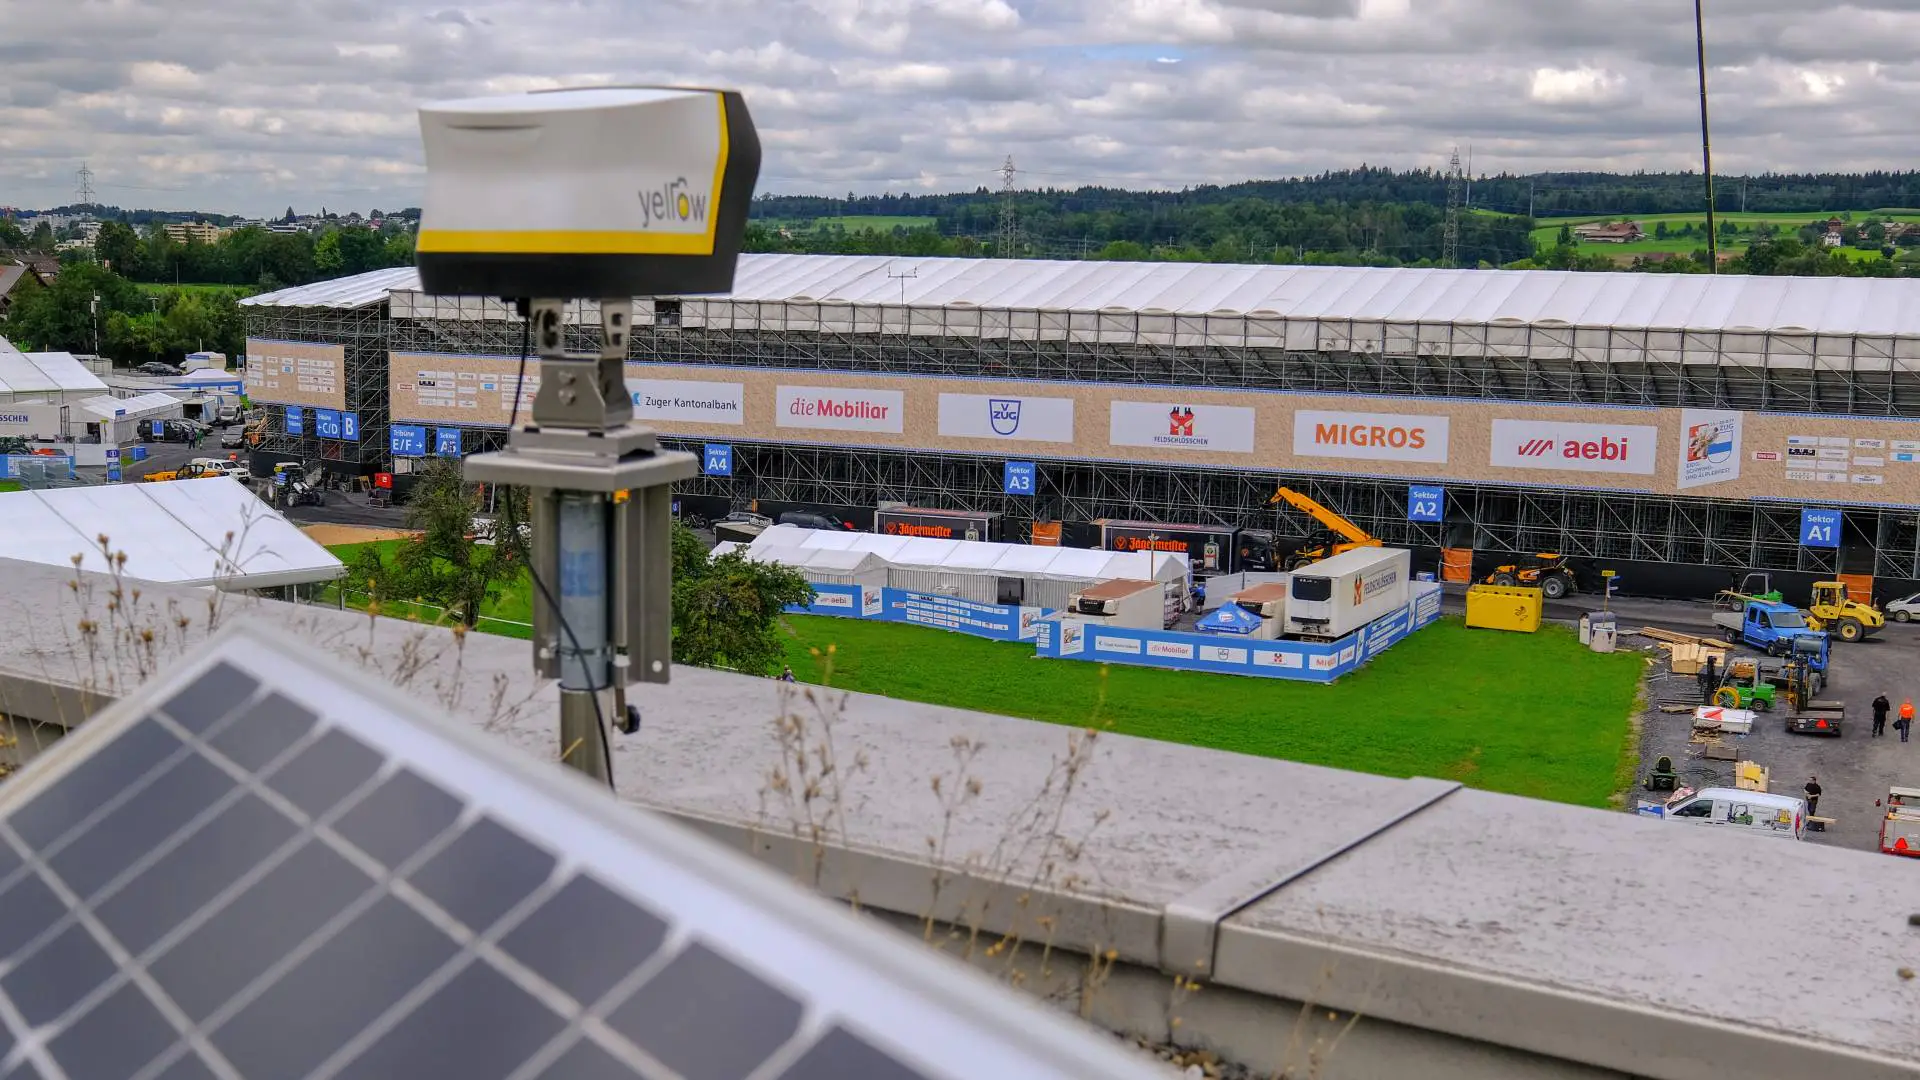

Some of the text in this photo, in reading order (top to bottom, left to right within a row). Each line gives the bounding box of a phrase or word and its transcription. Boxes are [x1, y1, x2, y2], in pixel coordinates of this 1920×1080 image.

[638, 178, 706, 228] yellow
[645, 396, 737, 411] Zuger Kantonalbank
[790, 398, 889, 420] die Mobiliar
[1000, 403, 1009, 411] V
[993, 411, 1016, 420] ZUG
[322, 422, 338, 435] C/D
[345, 417, 354, 436] B
[1315, 423, 1426, 450] MIGROS
[392, 438, 412, 451] E/F
[1563, 436, 1629, 461] aebi
[708, 448, 727, 456] Sektor
[708, 457, 727, 471] A4
[1009, 465, 1030, 474] Sektor
[1009, 476, 1030, 490] A3
[1413, 490, 1438, 500] Sektor
[1413, 501, 1437, 517] A2
[1807, 514, 1836, 525] Sektor
[1807, 525, 1832, 541] A1
[1129, 537, 1188, 552] Jägemeister
[1161, 645, 1189, 656] Mobiliar
